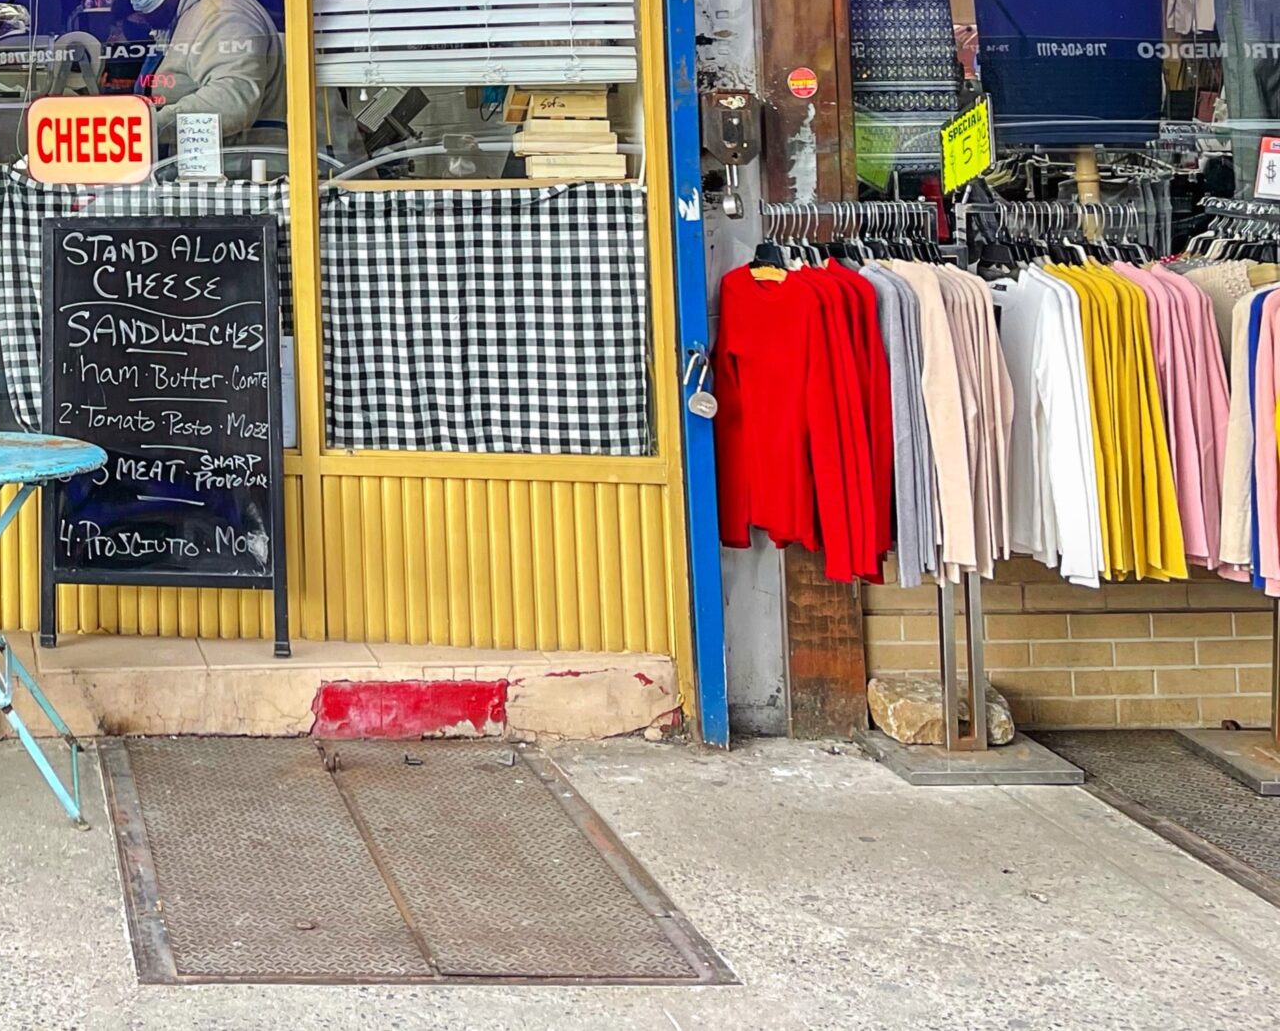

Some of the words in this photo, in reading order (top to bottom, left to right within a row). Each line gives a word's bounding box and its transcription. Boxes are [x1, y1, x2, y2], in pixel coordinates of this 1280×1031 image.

[36, 116, 143, 164] CHEESE
[948, 111, 982, 142] SPECIAL
[62, 232, 159, 266] STAND
[171, 234, 261, 265] ALONE
[93, 265, 221, 301] CHEESE
[67, 310, 265, 352] SANDWICHES
[81, 354, 138, 387] ham
[81, 405, 155, 433] Tomato
[116, 457, 185, 484] MEAT
[200, 453, 262, 471] SHARP
